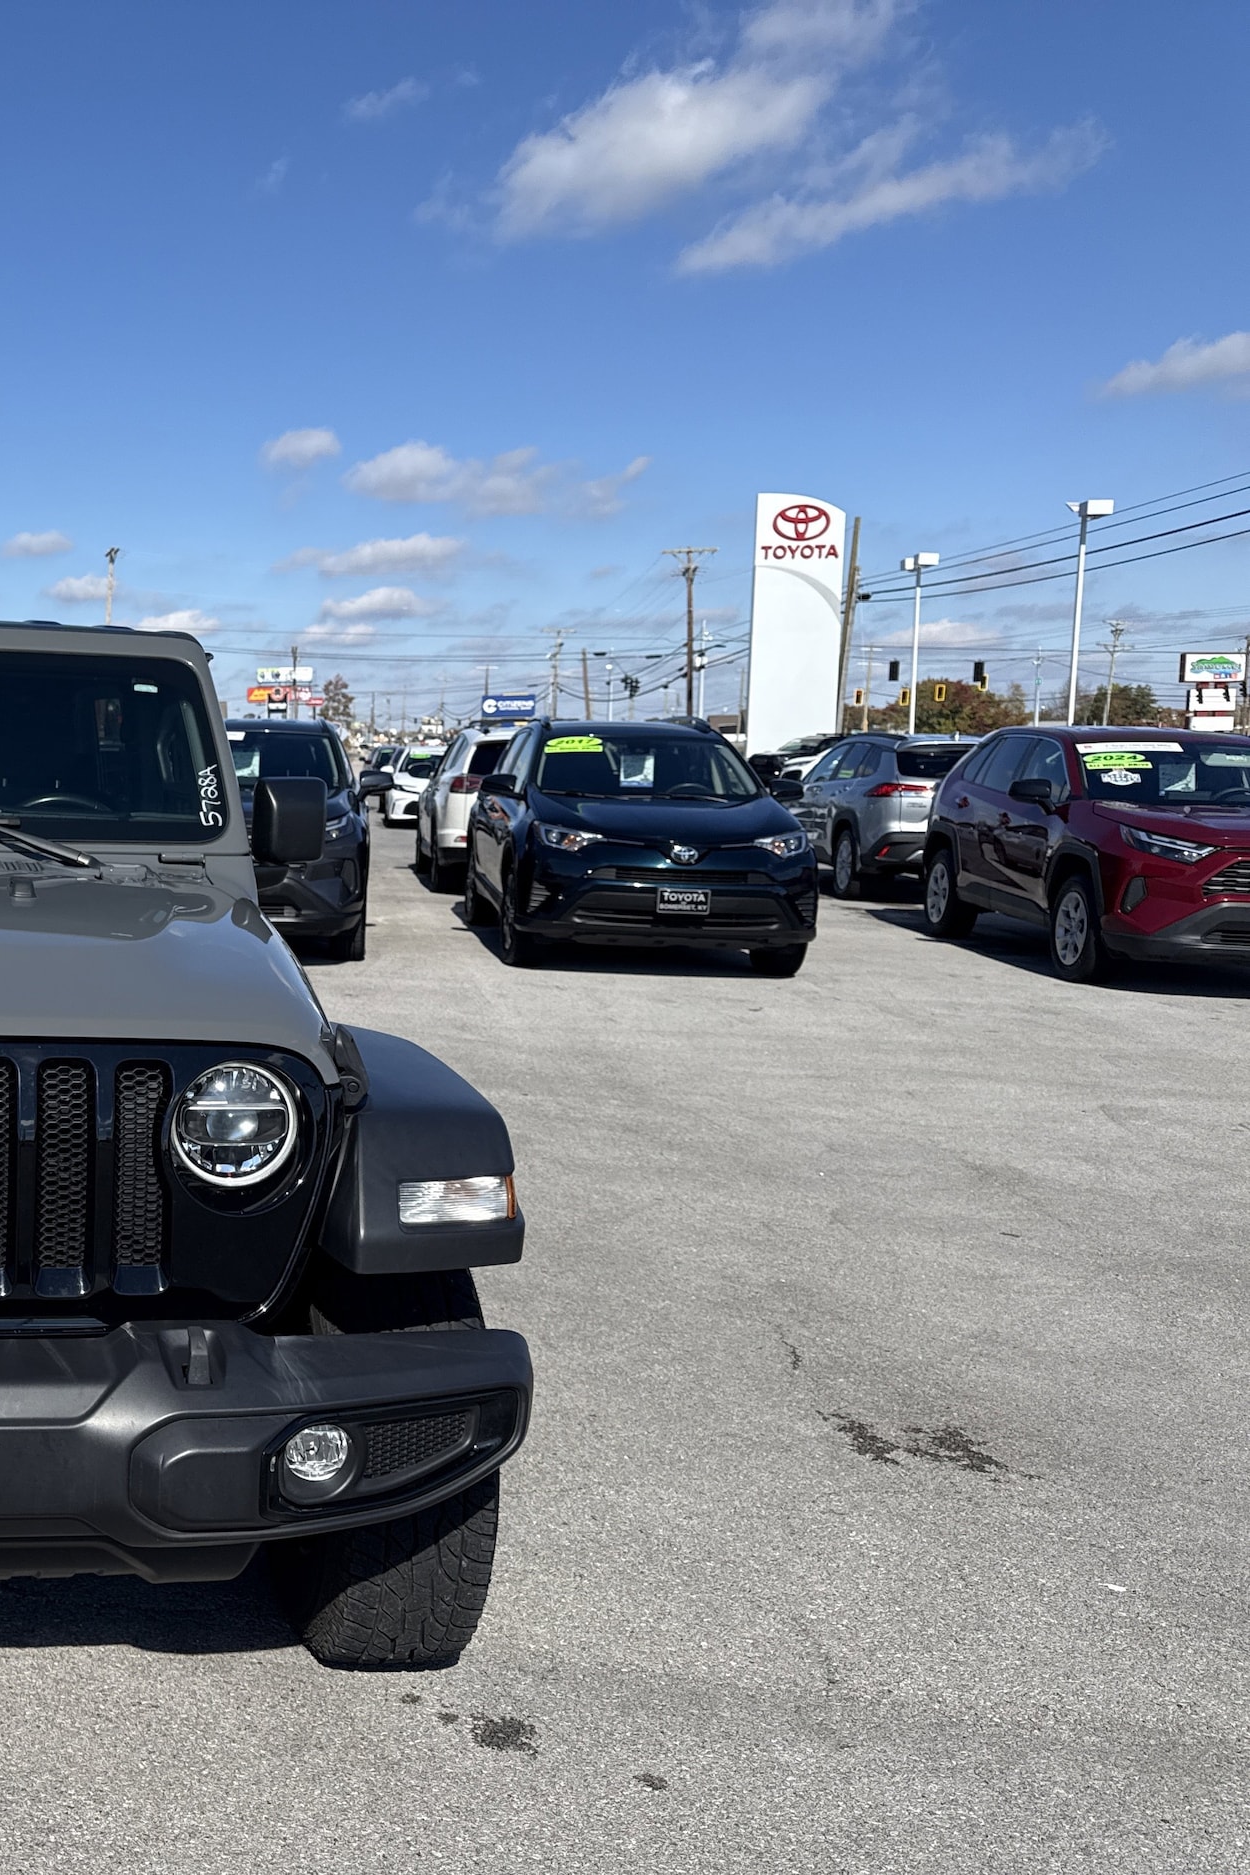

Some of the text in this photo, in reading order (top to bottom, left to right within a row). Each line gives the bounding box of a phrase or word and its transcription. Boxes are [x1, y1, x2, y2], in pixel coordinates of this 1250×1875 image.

[761, 544, 839, 560] TOYOTA
[554, 739, 595, 747] 2017
[1091, 754, 1138, 762] 2024
[198, 764, 223, 827] 5728A
[662, 892, 706, 902] TOYOTA
